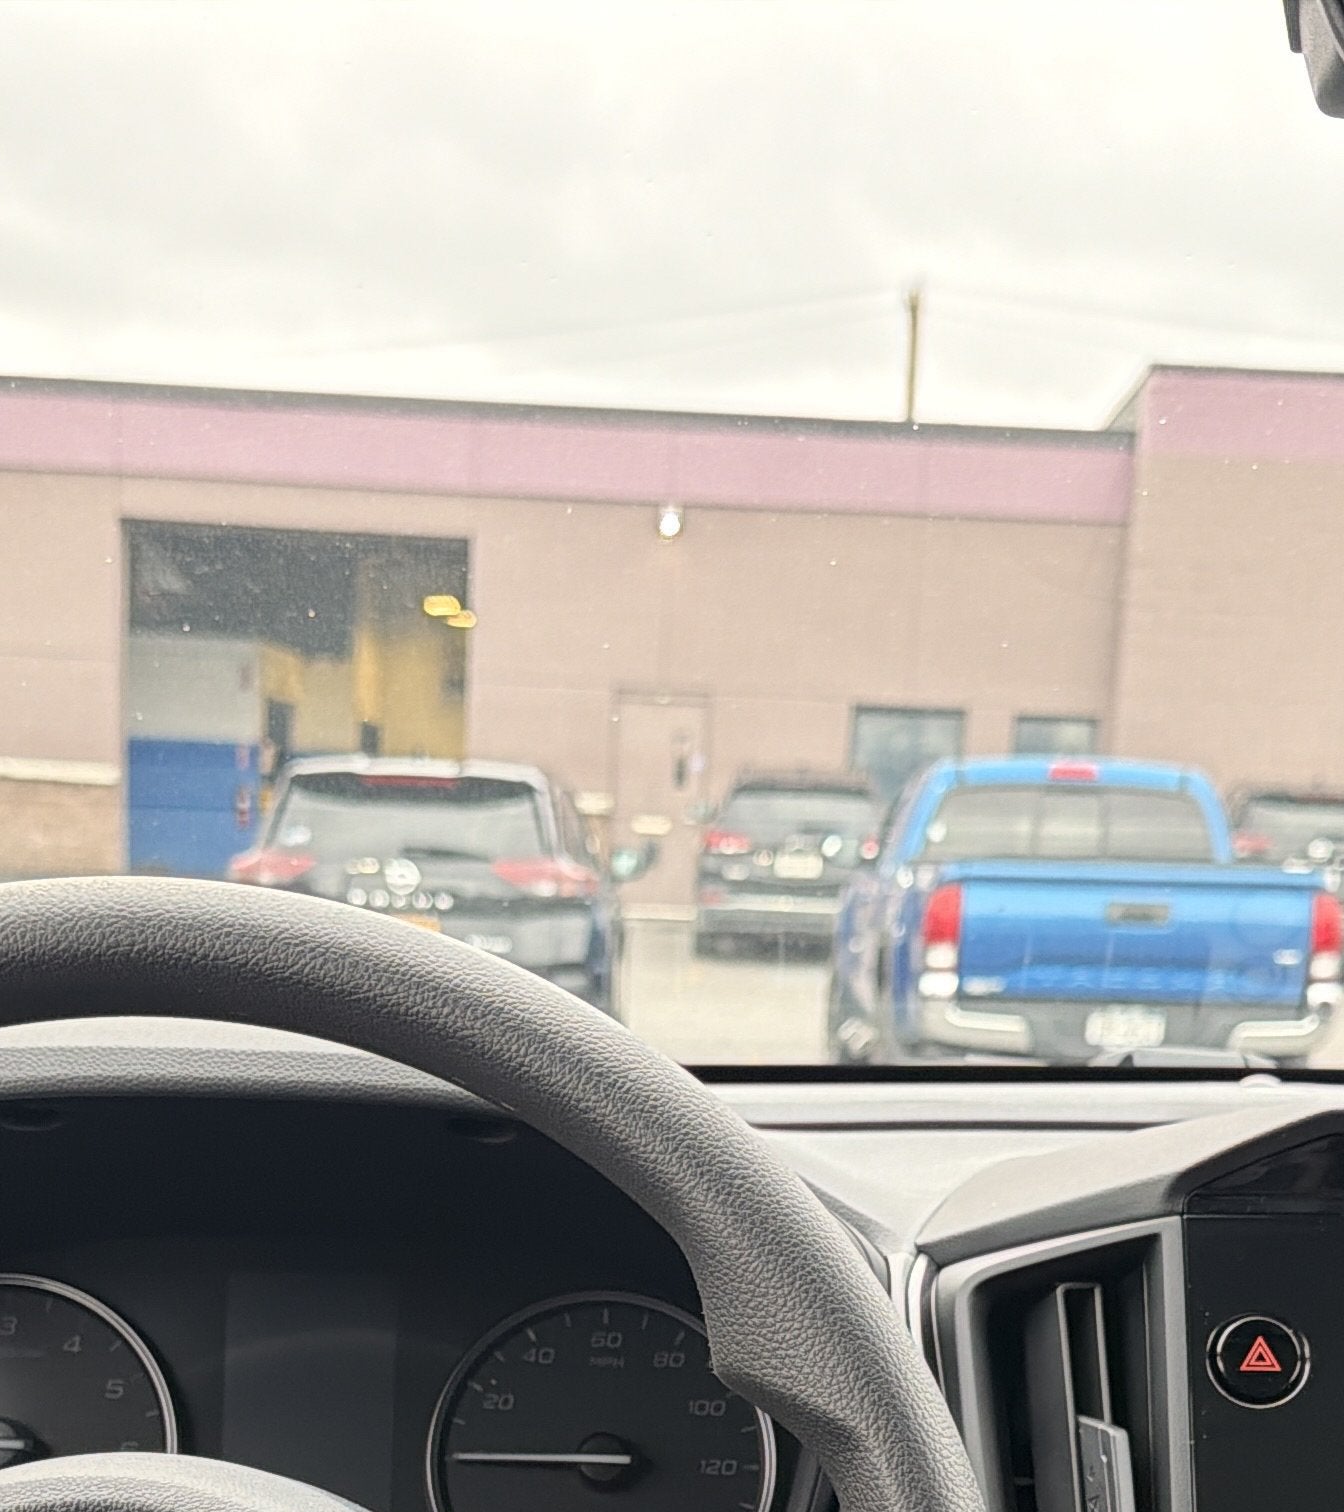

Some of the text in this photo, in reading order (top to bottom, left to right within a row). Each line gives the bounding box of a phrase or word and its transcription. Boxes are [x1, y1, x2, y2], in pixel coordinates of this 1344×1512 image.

[0, 1316, 19, 1337] 3
[62, 1334, 82, 1354] 4
[591, 1331, 623, 1349] 60
[522, 1347, 556, 1365] 40
[654, 1351, 686, 1369] 80
[104, 1379, 126, 1400] 5
[482, 1392, 515, 1411] 20
[688, 1400, 727, 1417] 100
[699, 1459, 739, 1477] 120
